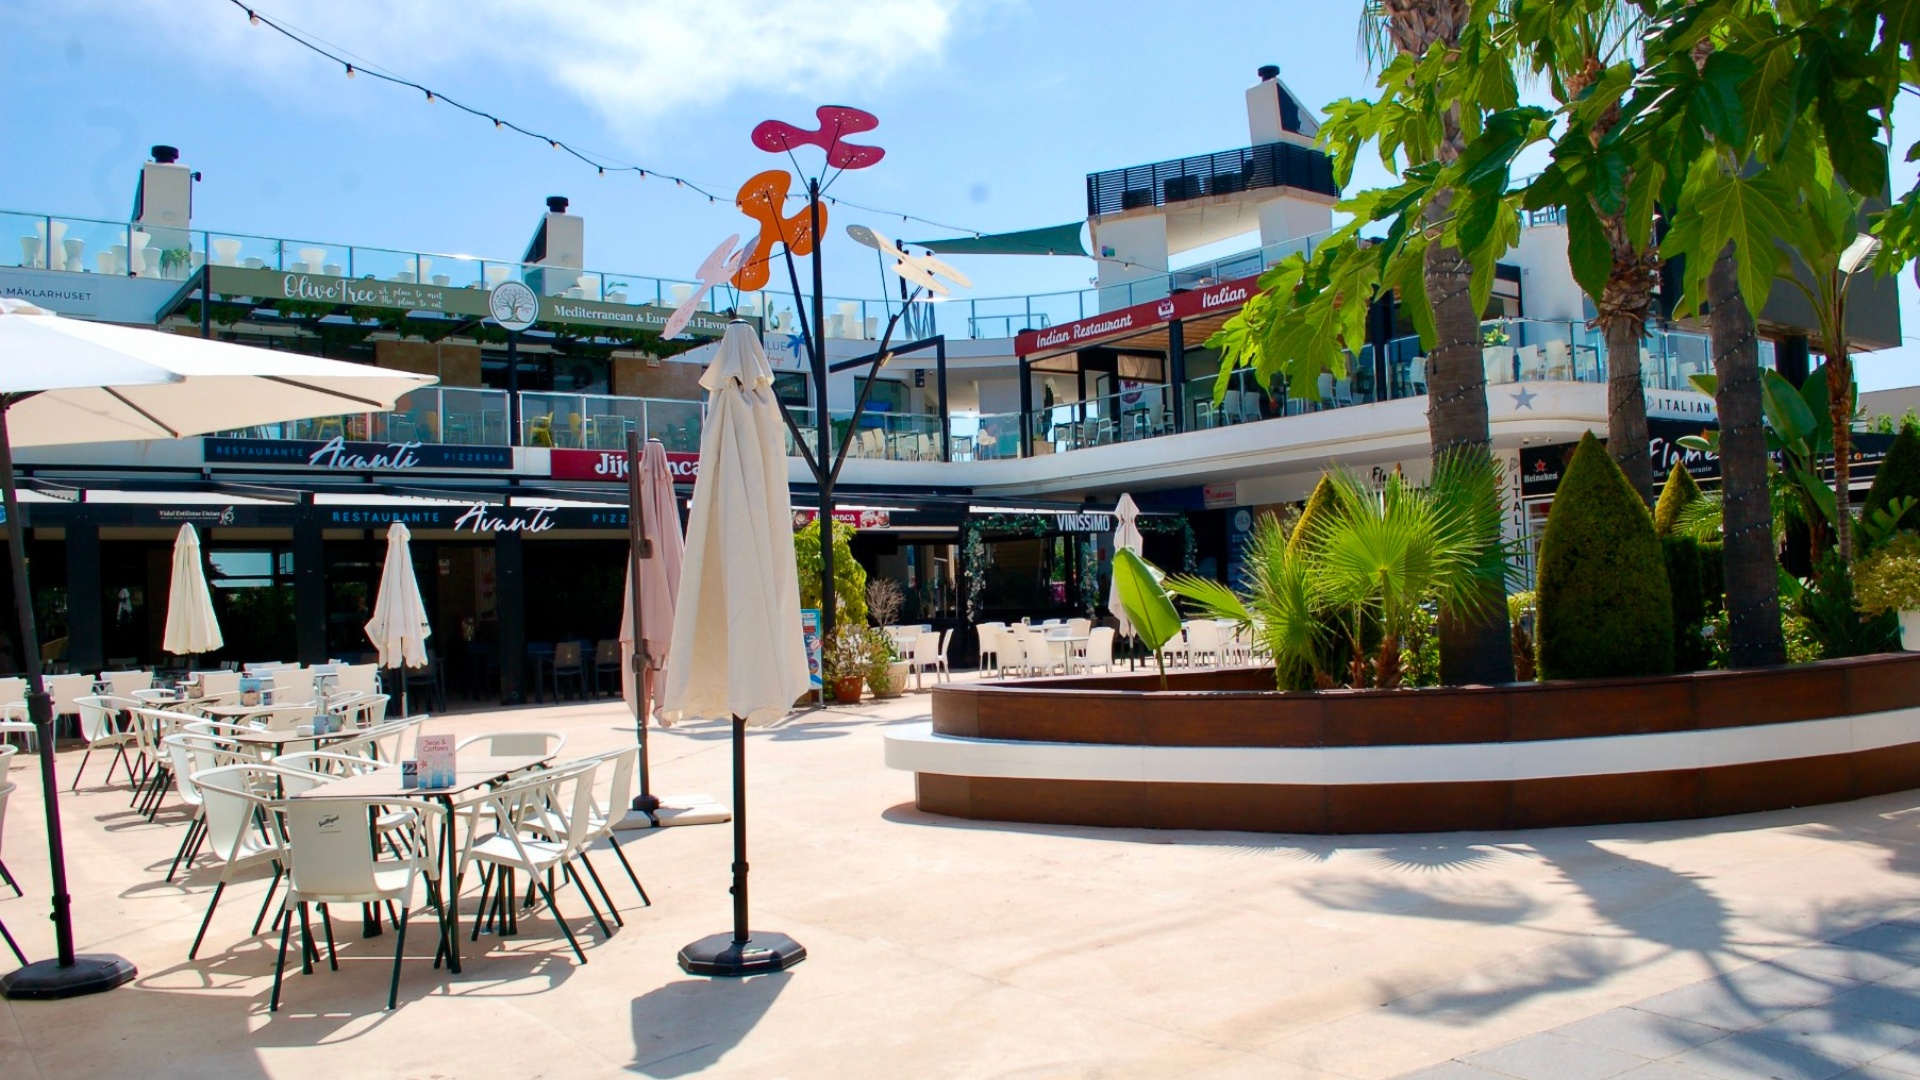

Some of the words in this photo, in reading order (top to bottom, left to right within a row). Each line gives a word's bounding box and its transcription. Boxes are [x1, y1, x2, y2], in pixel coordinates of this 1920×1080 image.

[393, 287, 411, 298] place
[416, 290, 422, 298] to
[1202, 285, 1248, 308] Italian
[398, 297, 415, 307] place
[420, 299, 426, 307] to
[554, 305, 634, 322] Mediterranean
[636, 315, 644, 323] &
[1036, 330, 1071, 349] Indian
[1073, 314, 1132, 338] Restaurant
[764, 340, 787, 352] LUE
[1658, 398, 1711, 414] ITALIAN
[216, 446, 304, 457] RESTAURANTE
[309, 435, 422, 470] Avanti
[444, 452, 505, 463] PIZZERIA
[1523, 472, 1558, 483] Heineken
[332, 512, 440, 523] RESTAURANTE
[454, 501, 557, 533] Avanti
[1056, 513, 1110, 532] VINISSIMO
